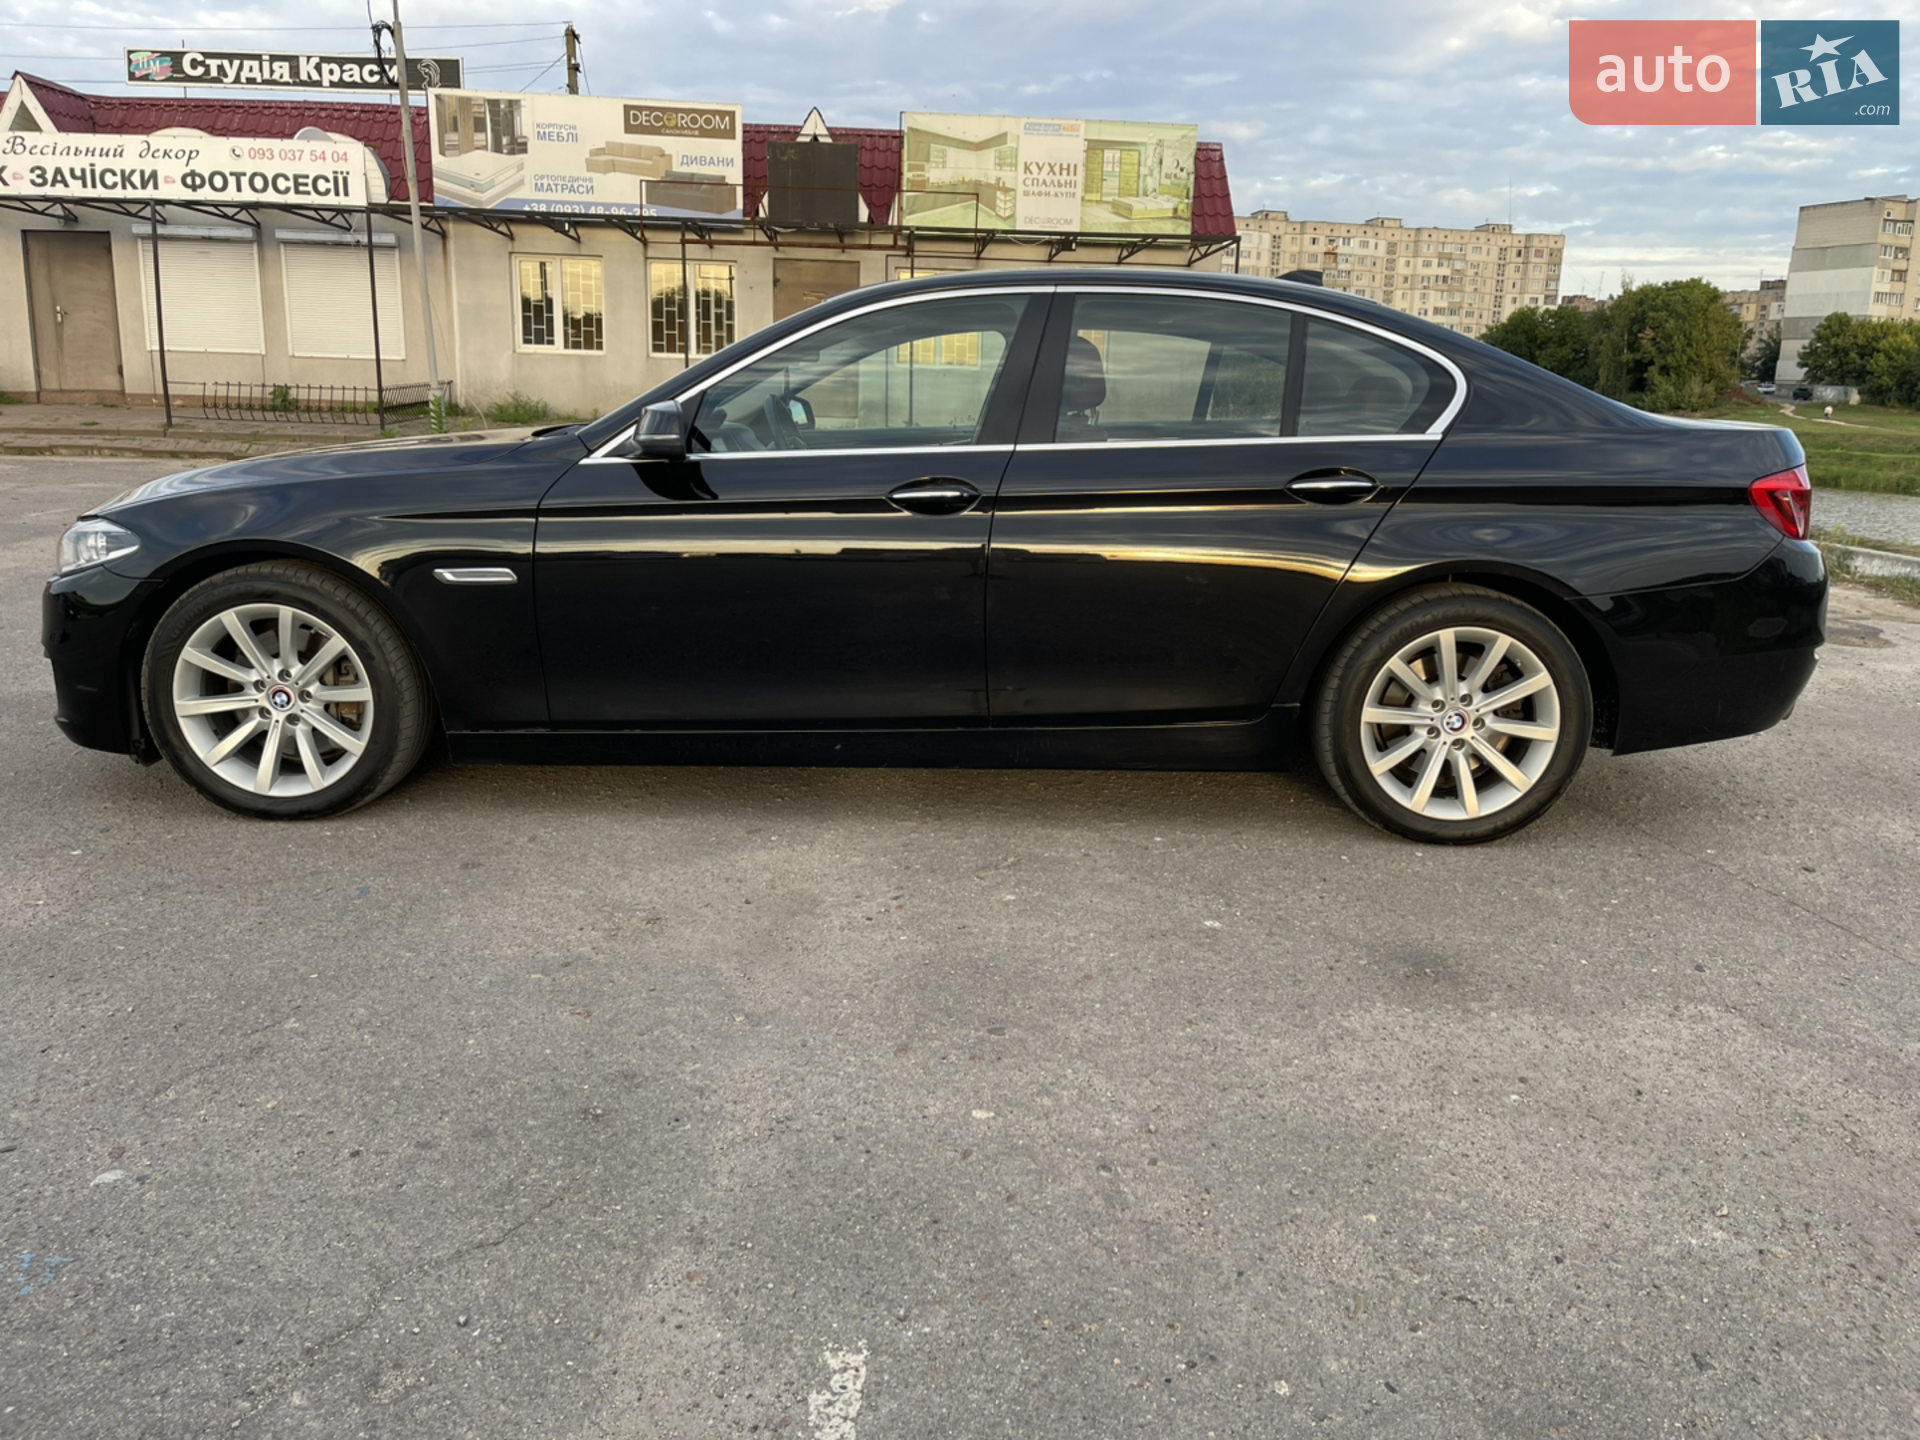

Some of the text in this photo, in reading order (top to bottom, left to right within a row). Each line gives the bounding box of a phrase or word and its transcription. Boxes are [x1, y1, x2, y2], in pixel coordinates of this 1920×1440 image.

[182, 52, 399, 87] Студія Краси
[536, 122, 577, 131] КОРПУСНІ
[629, 110, 730, 130] DECOROOM
[536, 131, 579, 143] МЕБЛІ
[2, 135, 200, 167] Весільний декор
[248, 147, 349, 164] 093 037 54 04
[680, 154, 735, 168] ДИВАНИ
[1023, 161, 1077, 177] КУХНІ
[533, 173, 594, 184] ОРТОПЕДИЧНІ
[1022, 177, 1077, 189] СПАЛЬНІ
[534, 182, 595, 195] МАТРАСИ
